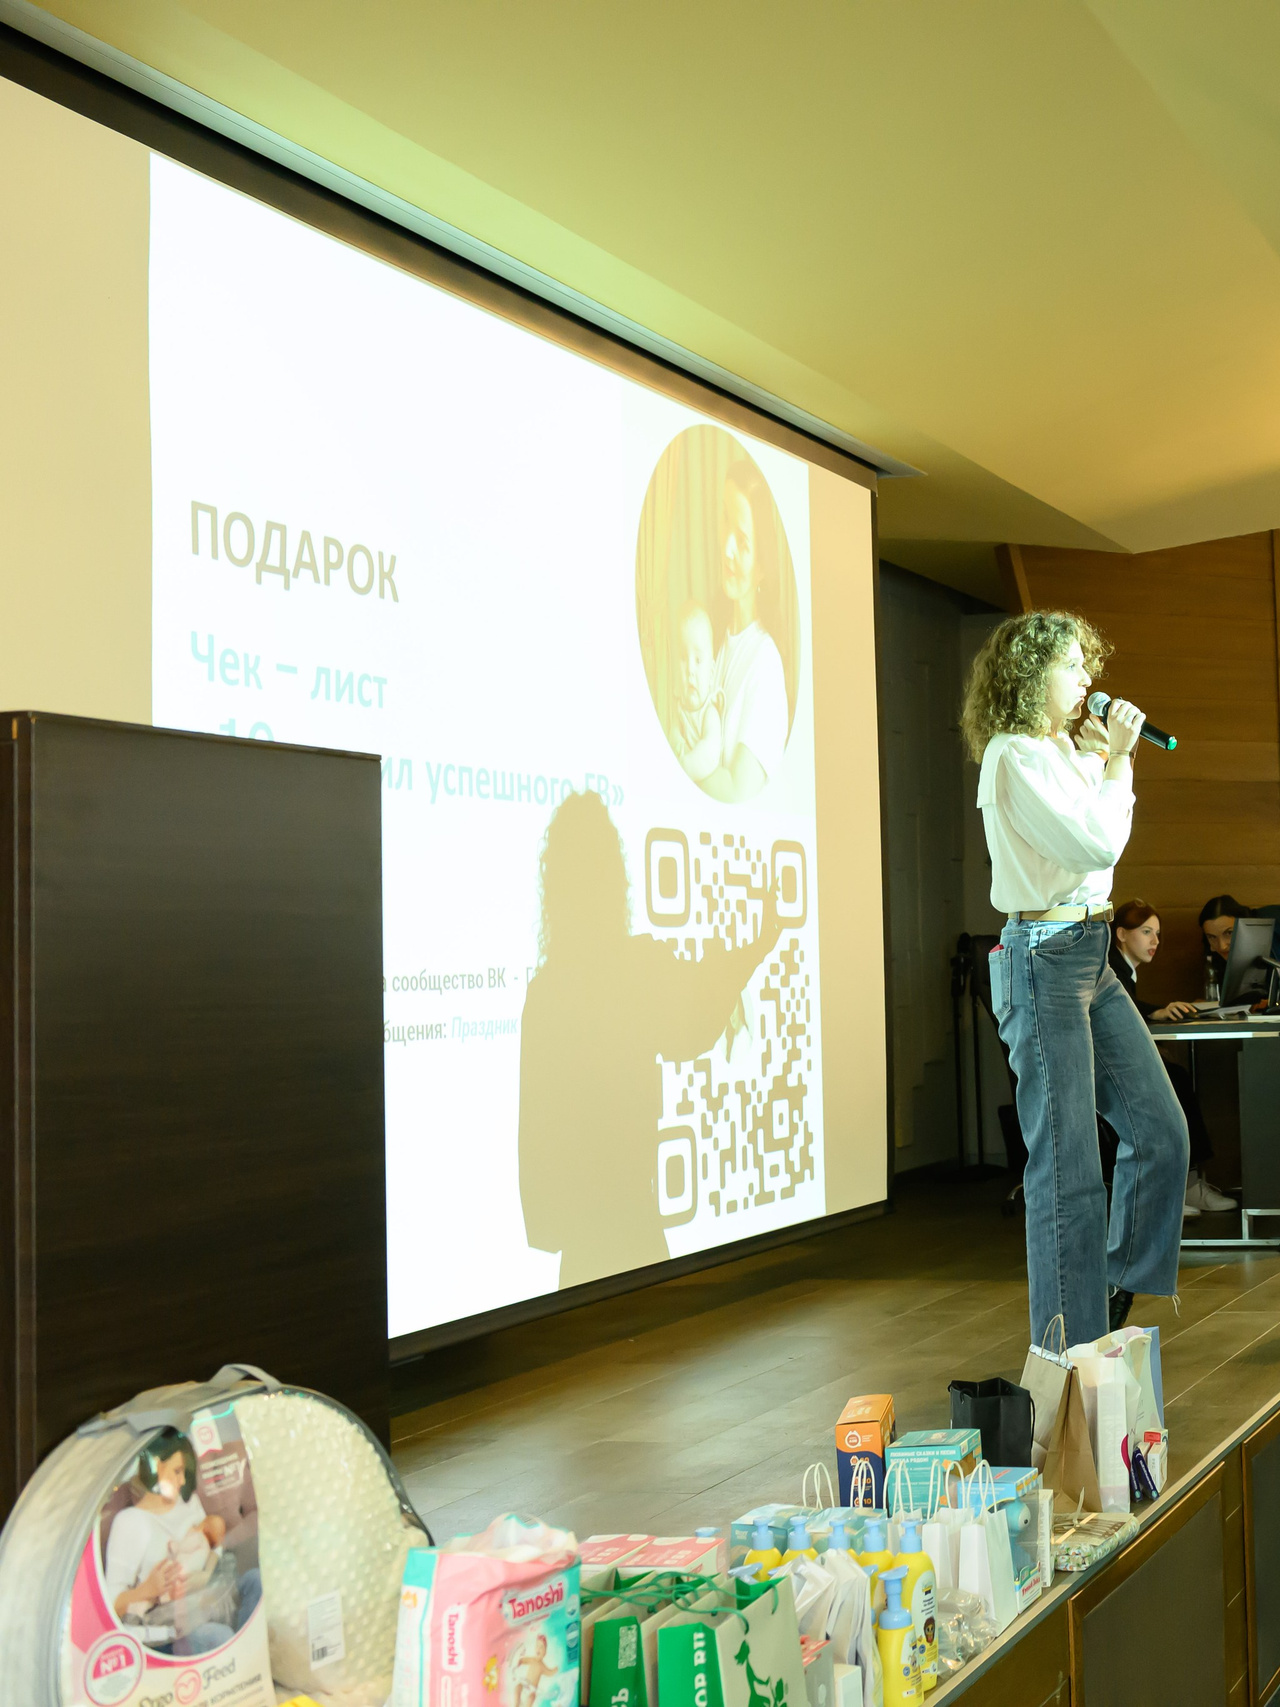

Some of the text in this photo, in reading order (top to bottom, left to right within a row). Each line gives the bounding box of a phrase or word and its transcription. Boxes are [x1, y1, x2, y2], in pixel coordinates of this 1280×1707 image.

[191, 500, 399, 603] ПОДАРОК
[191, 631, 263, 690] Чек
[310, 666, 388, 709] лист
[392, 969, 484, 995] сообщество
[488, 967, 507, 988] ВК
[452, 1016, 518, 1043] Праздник
[508, 1582, 565, 1620] Tanoshi
[447, 1613, 460, 1667] Tanoshi
